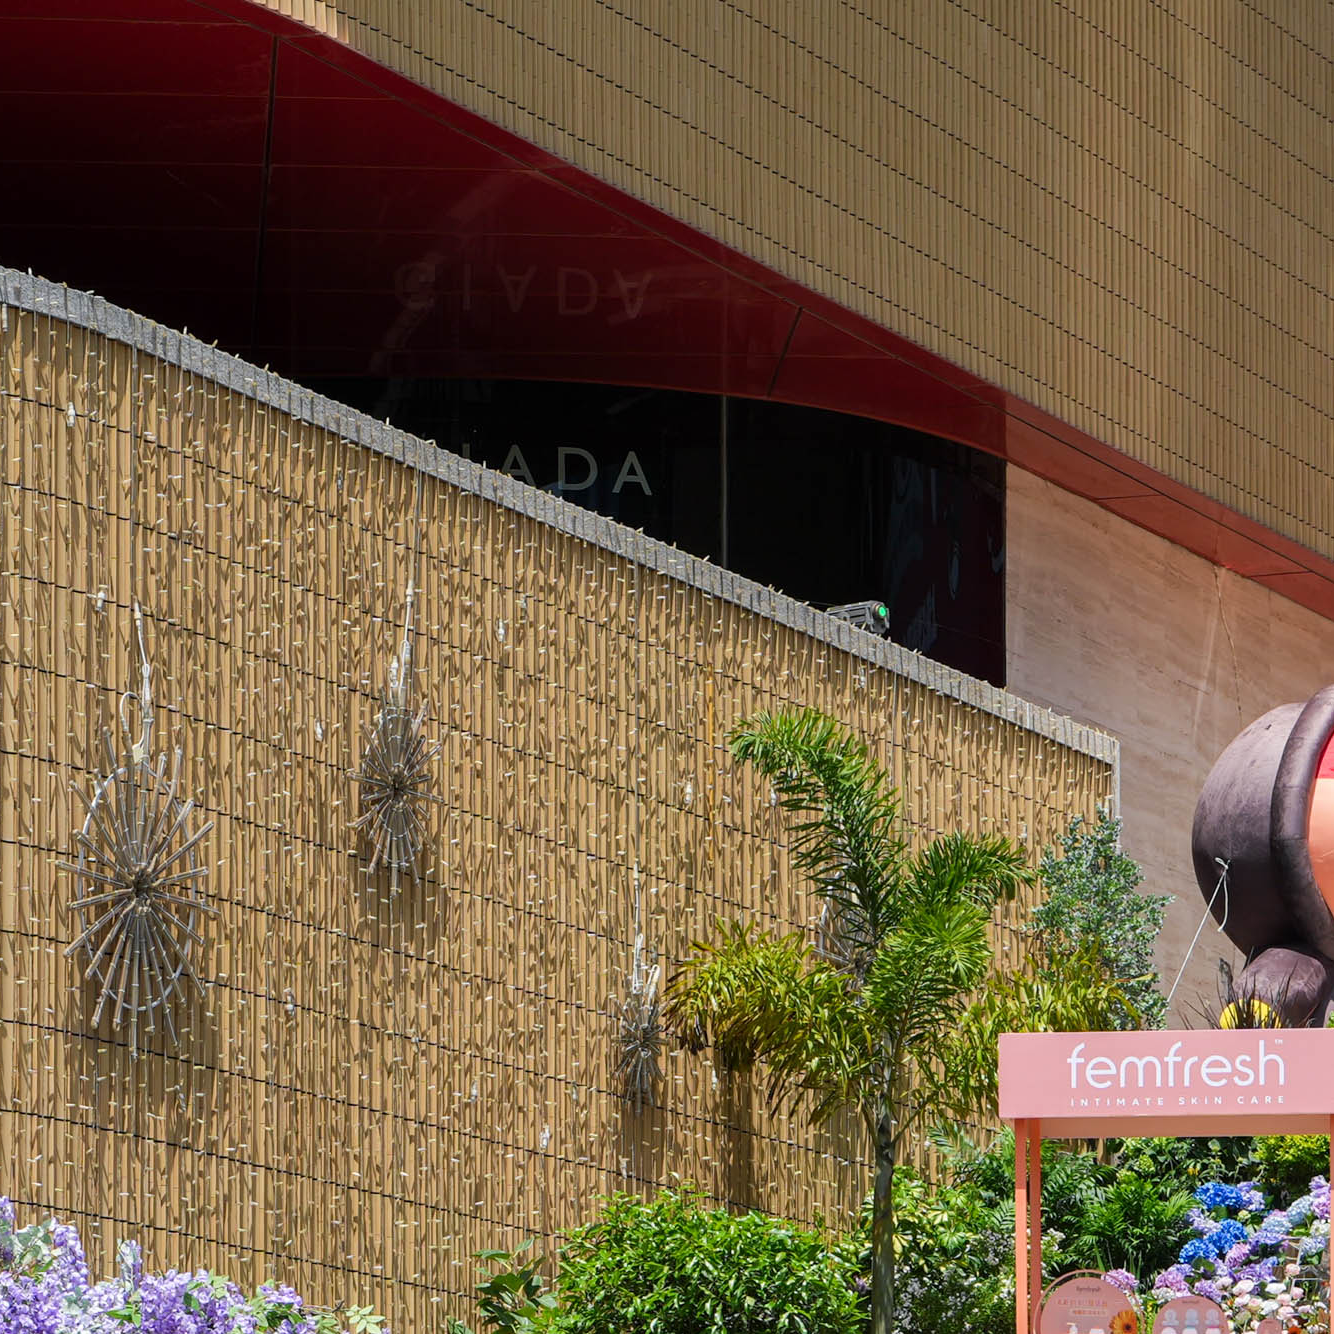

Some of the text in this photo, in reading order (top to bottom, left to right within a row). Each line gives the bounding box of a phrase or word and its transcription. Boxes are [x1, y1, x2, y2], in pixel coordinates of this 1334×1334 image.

[1067, 1039, 1285, 1088] femfresh
[1070, 1095, 1284, 1107] INTIMATE SKIN CARE
